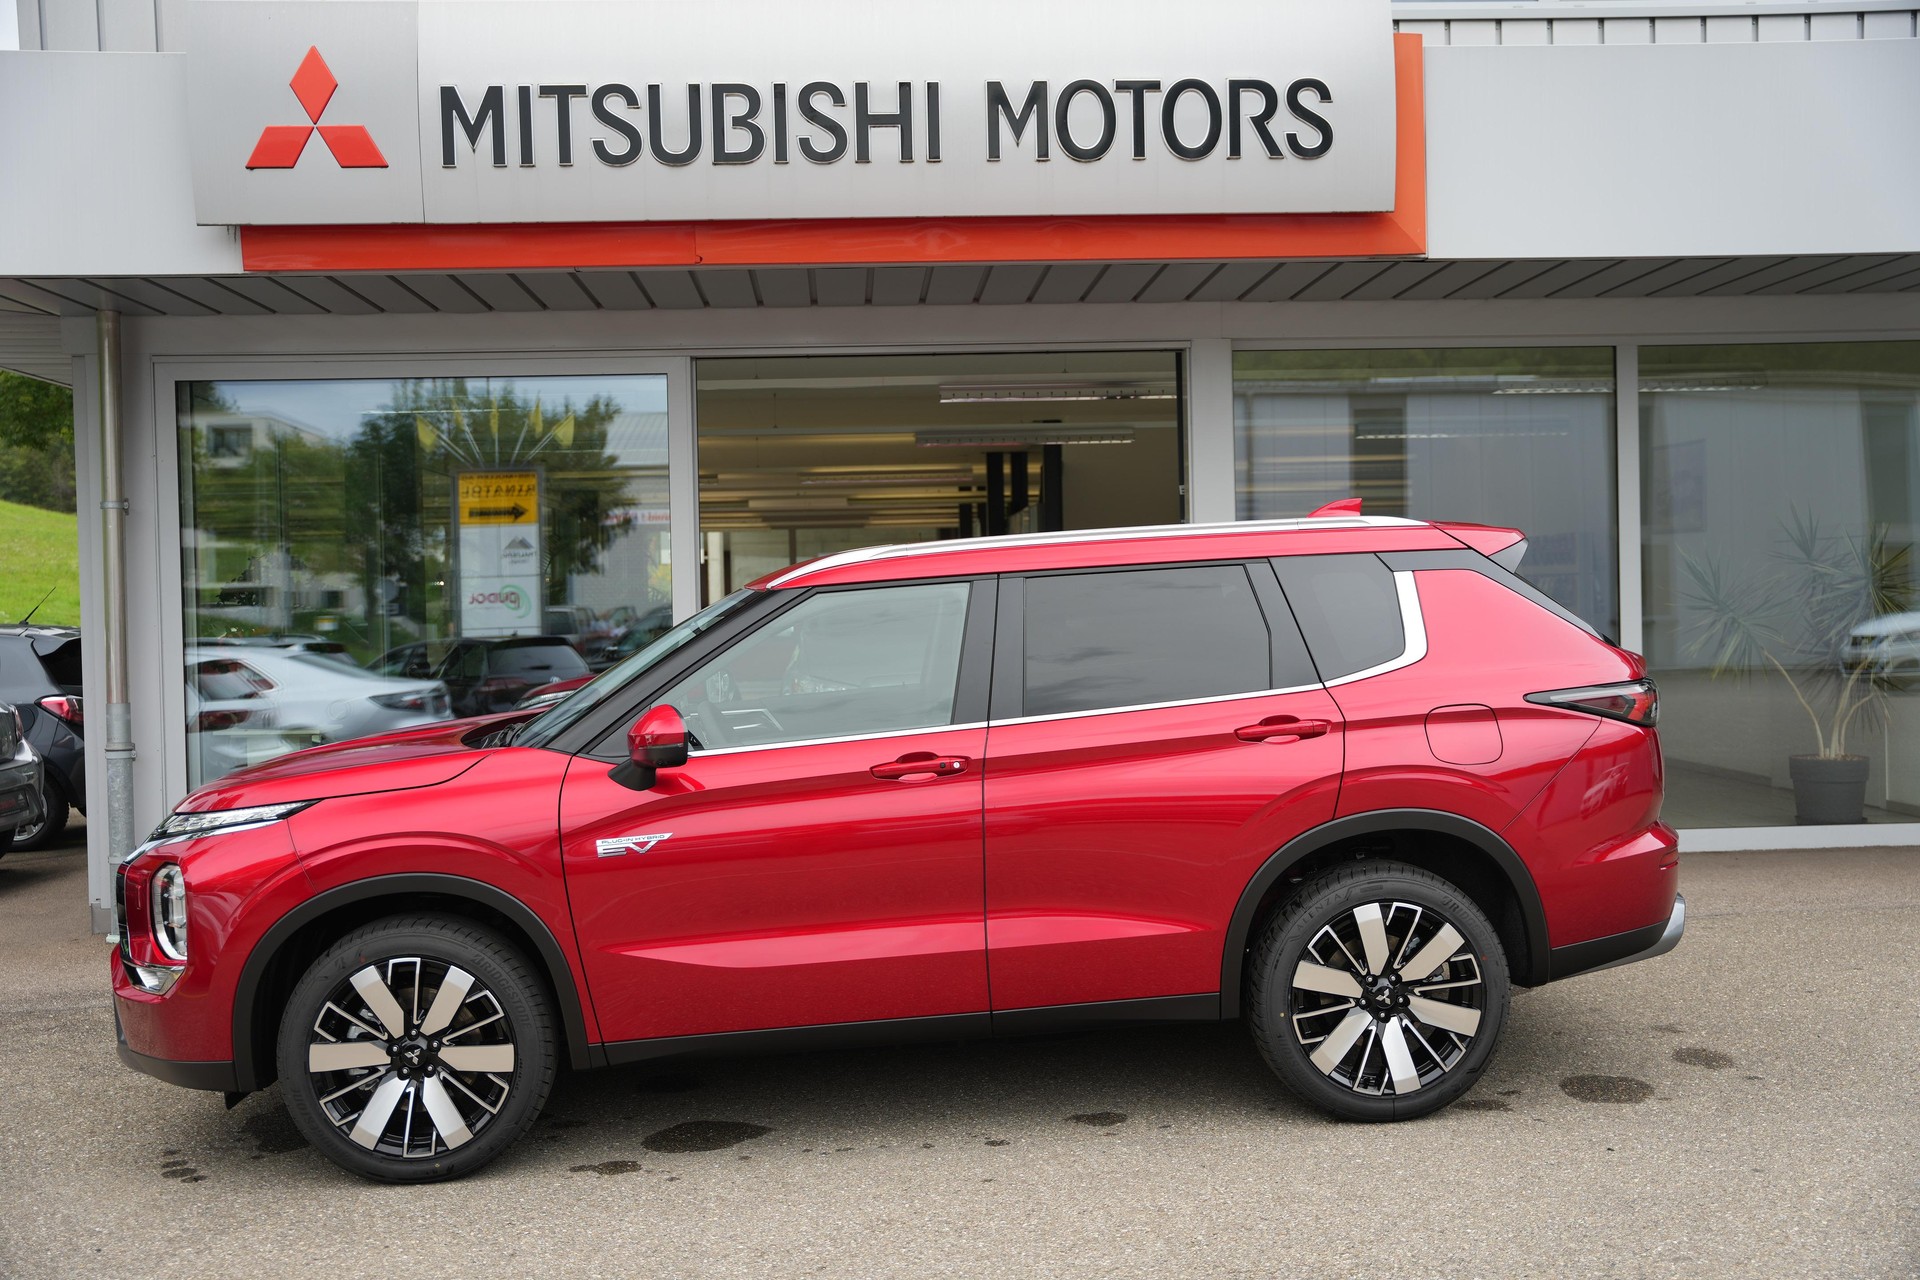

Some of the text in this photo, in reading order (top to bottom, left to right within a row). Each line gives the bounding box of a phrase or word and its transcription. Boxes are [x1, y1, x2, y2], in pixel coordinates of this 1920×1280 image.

[439, 76, 1334, 168] MITSUBISHI MOTORS
[596, 840, 660, 858] EV
[601, 834, 666, 845] PLUG-IN HYBRID
[1298, 892, 1342, 931] ALENZA
[470, 953, 532, 1028] BRIDGESTONE
